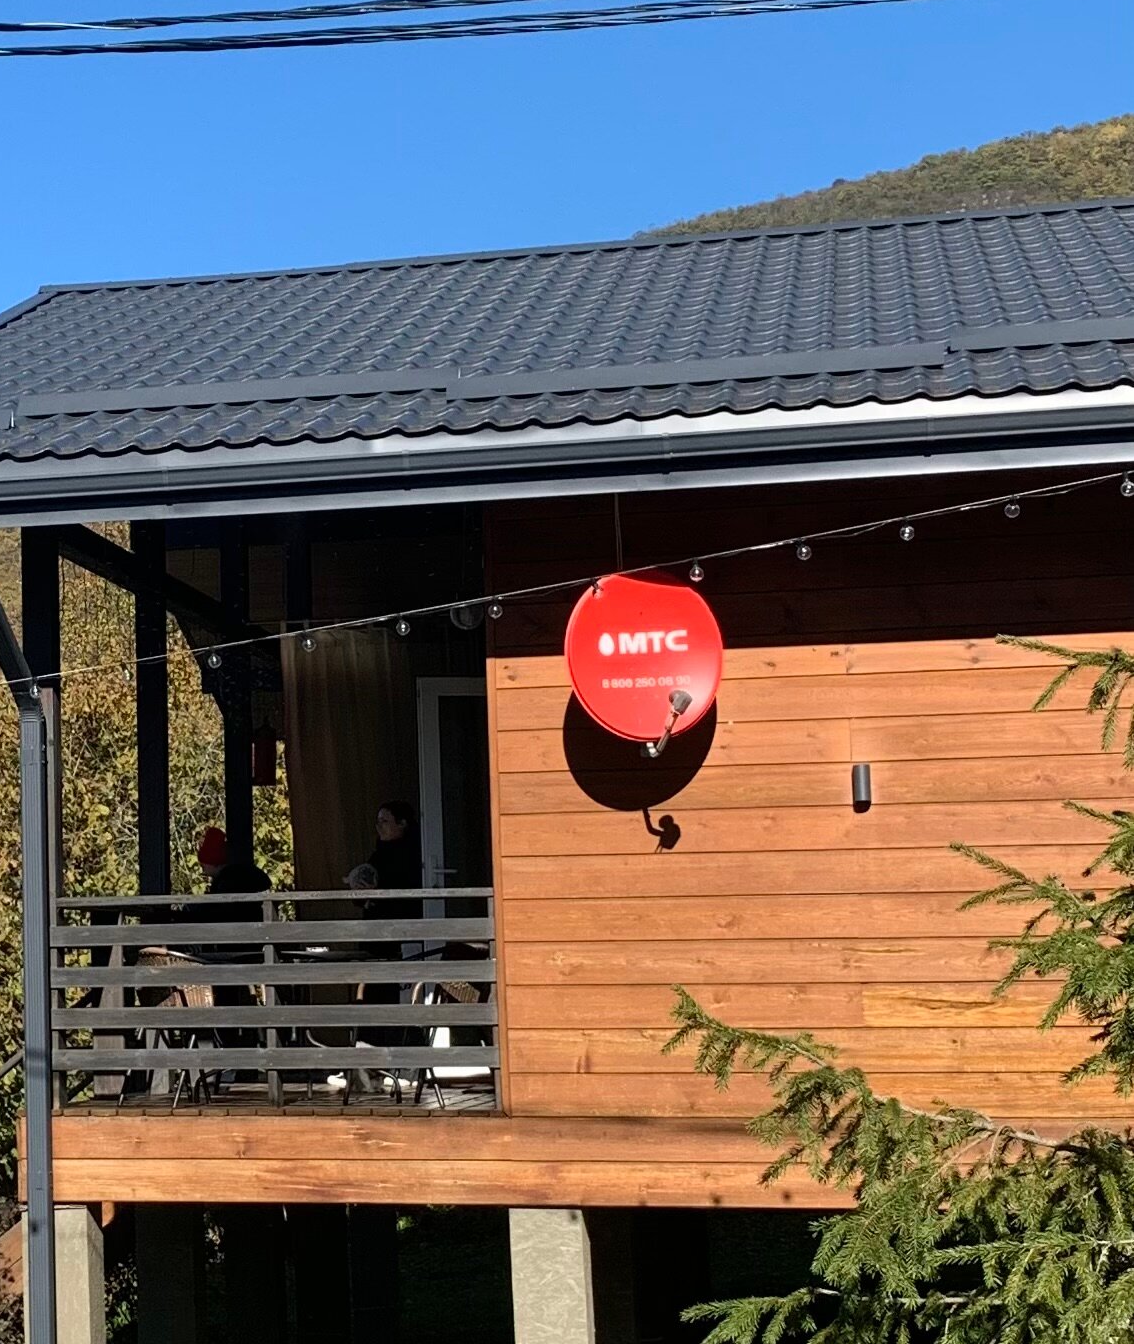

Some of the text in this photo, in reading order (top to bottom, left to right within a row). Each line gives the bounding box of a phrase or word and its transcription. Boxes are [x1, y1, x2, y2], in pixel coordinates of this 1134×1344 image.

[618, 629, 689, 654] МТС
[601, 678, 610, 689] 8
[635, 677, 656, 688] 250
[657, 676, 674, 687] 08
[675, 675, 691, 686] 90
